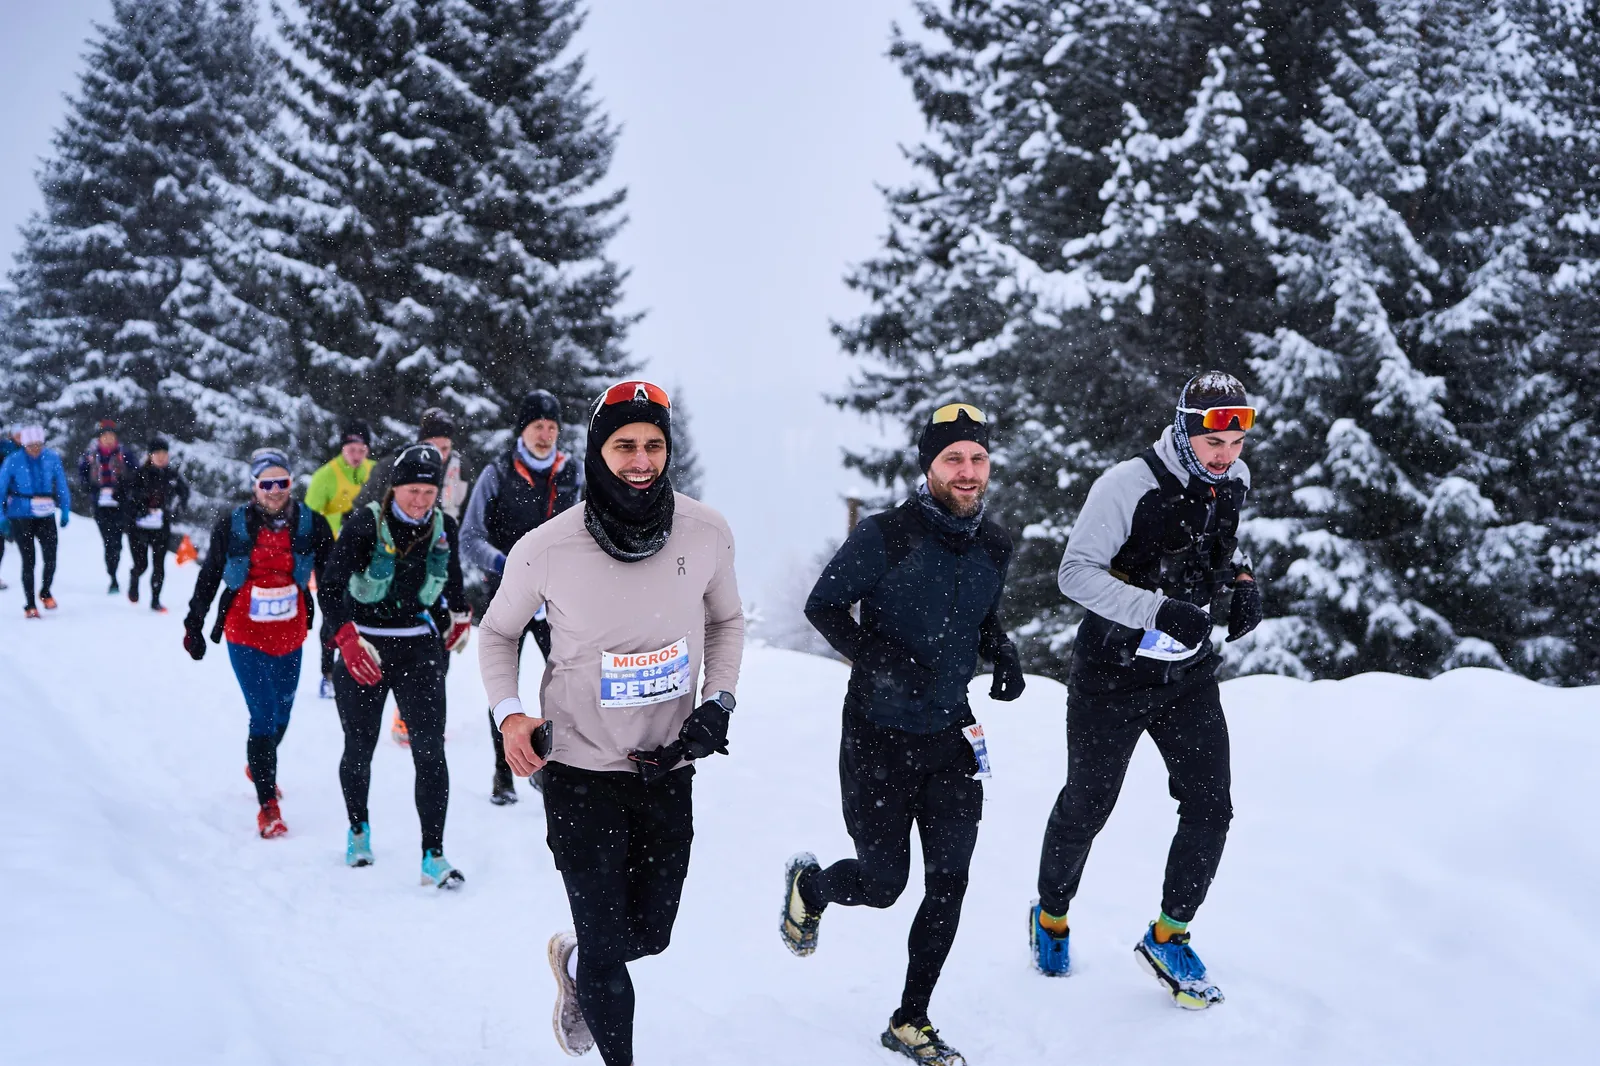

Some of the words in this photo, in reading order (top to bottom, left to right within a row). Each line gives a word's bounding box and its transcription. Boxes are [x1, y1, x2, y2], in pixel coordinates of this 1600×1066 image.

[613, 645, 679, 668] MIGROS
[642, 667, 663, 678] 634
[610, 673, 681, 697] PETER
